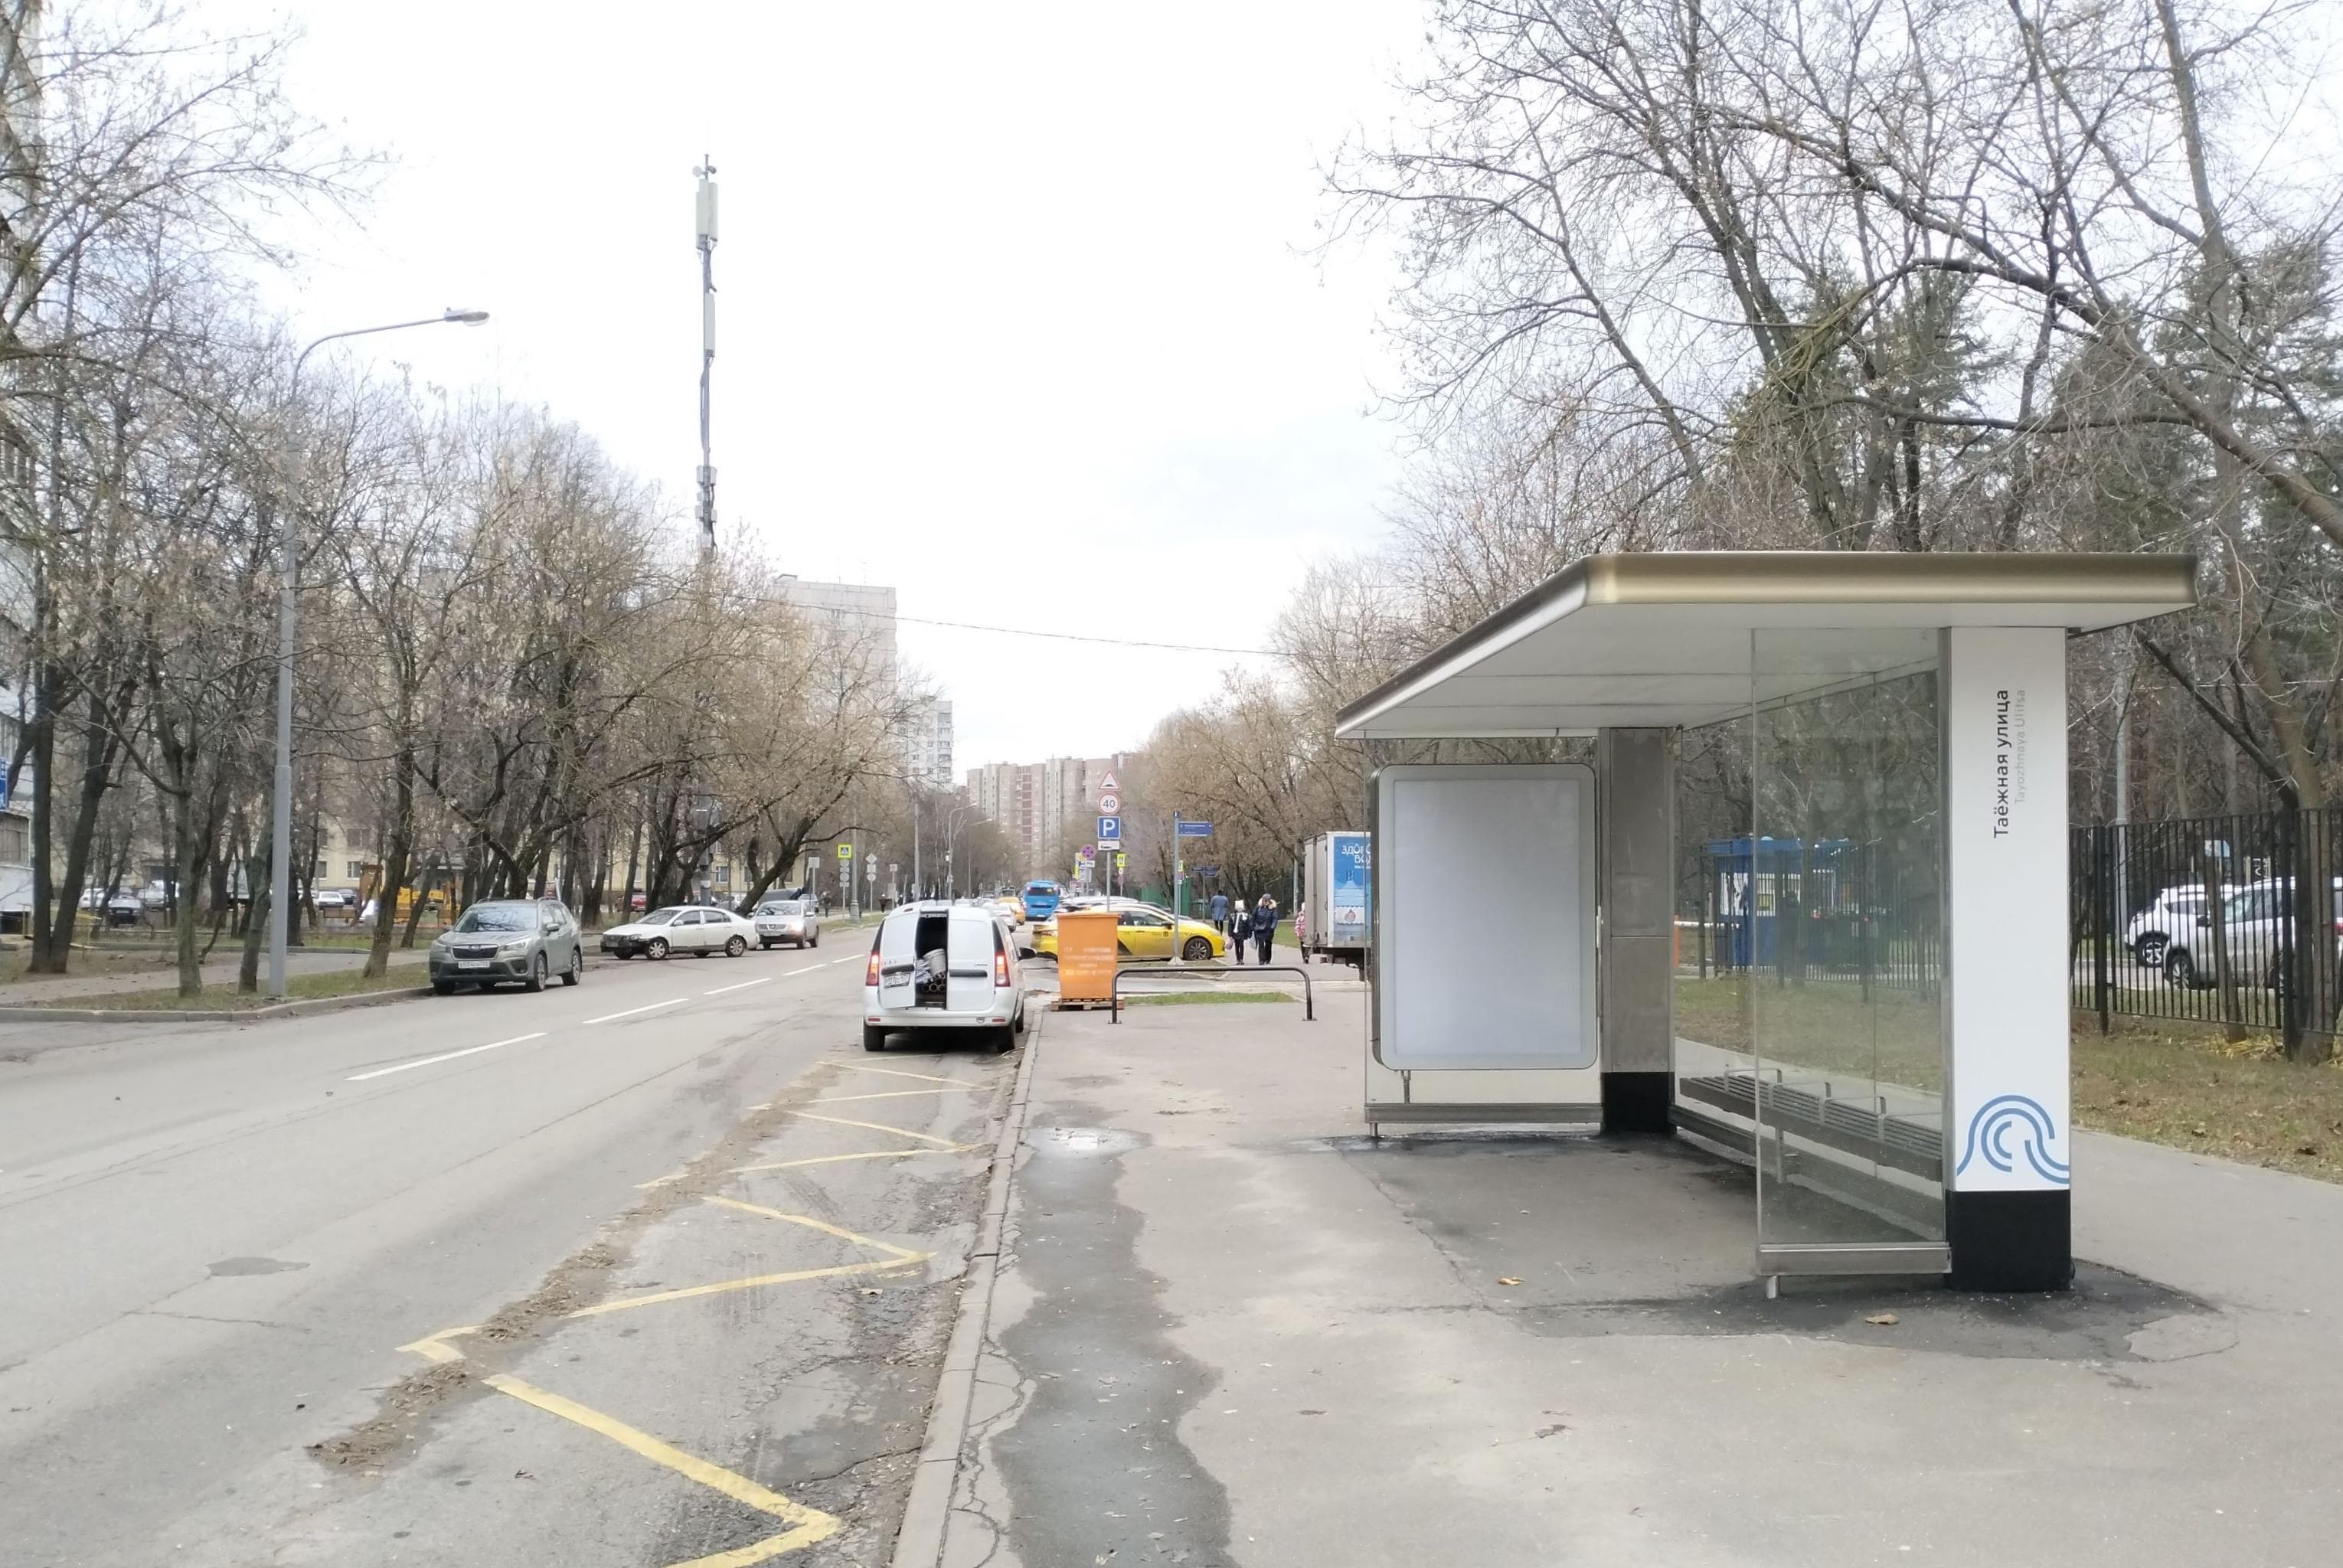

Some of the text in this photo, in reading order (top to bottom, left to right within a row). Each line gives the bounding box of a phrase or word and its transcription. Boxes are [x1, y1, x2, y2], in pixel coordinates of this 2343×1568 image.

[1103, 799, 1115, 808] 40
[1994, 690, 2011, 838] Таёжная улица
[2015, 690, 2027, 804] Tayozhnaya Ulitsa
